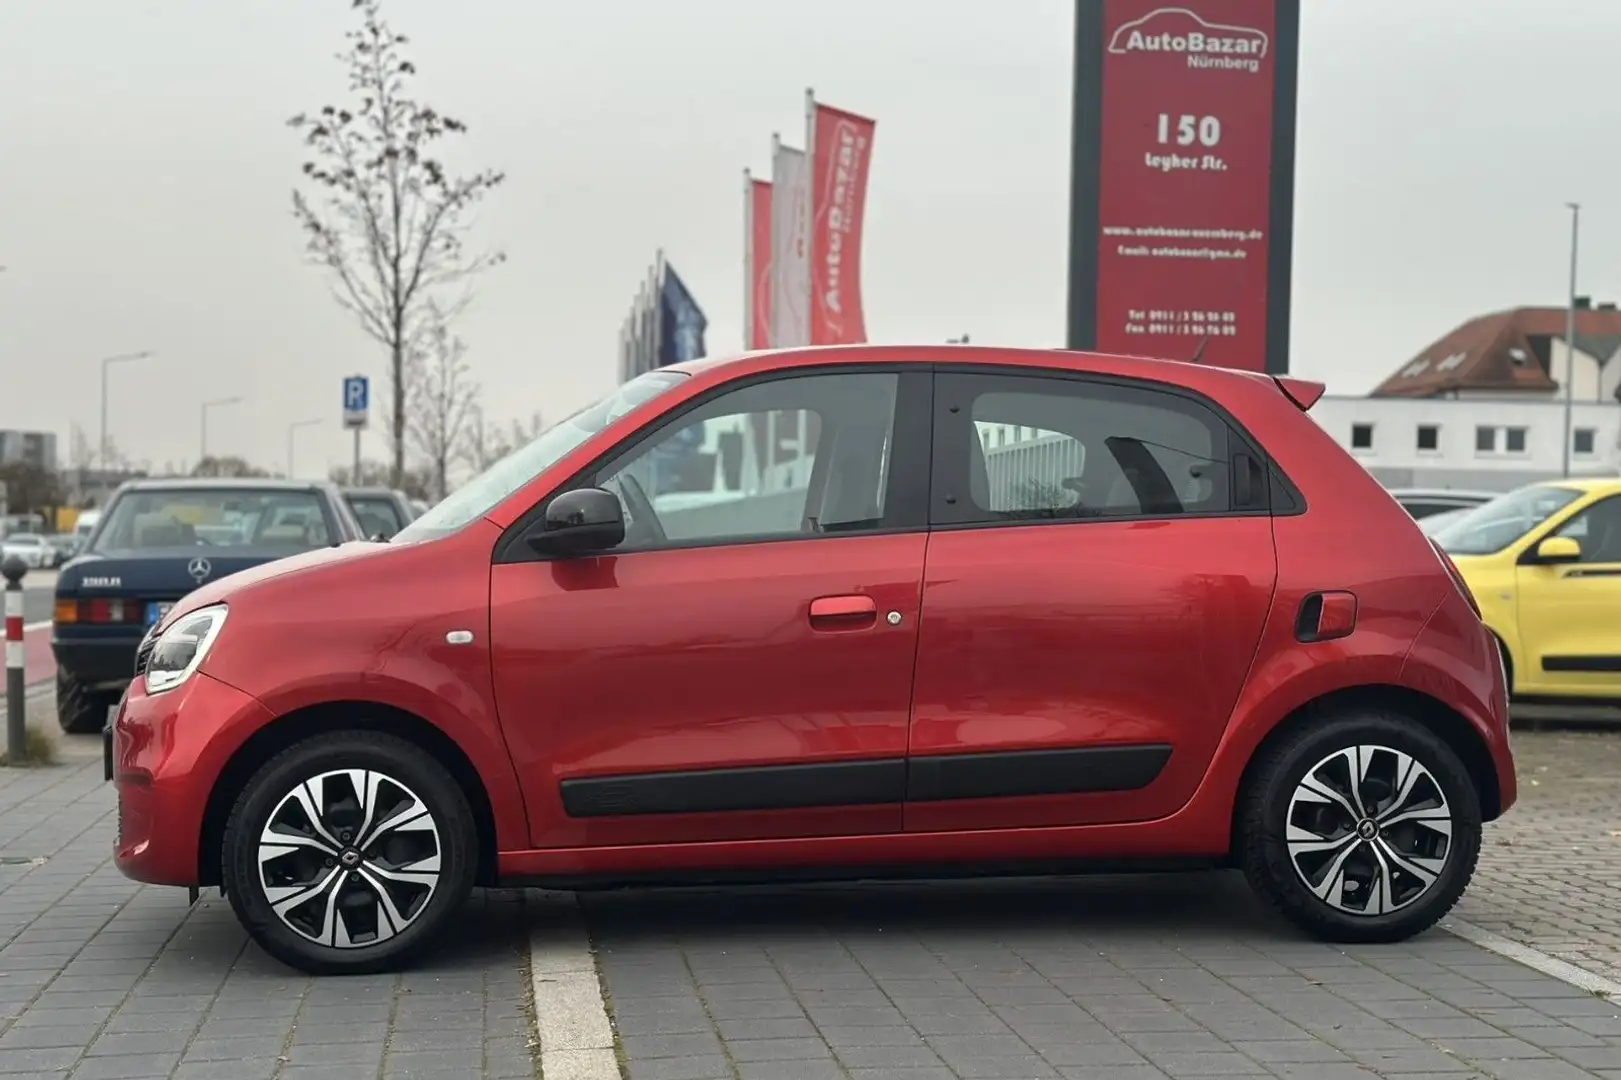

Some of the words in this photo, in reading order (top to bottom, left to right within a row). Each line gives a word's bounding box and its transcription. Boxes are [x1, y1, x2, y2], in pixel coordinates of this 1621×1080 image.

[1126, 30, 1262, 54] AutoBazar
[1187, 54, 1259, 73] Nürnberg
[1157, 113, 1221, 146] 150
[1145, 152, 1199, 172] Leyher
[1201, 154, 1228, 171] Str.
[825, 125, 856, 314] AutoBazar
